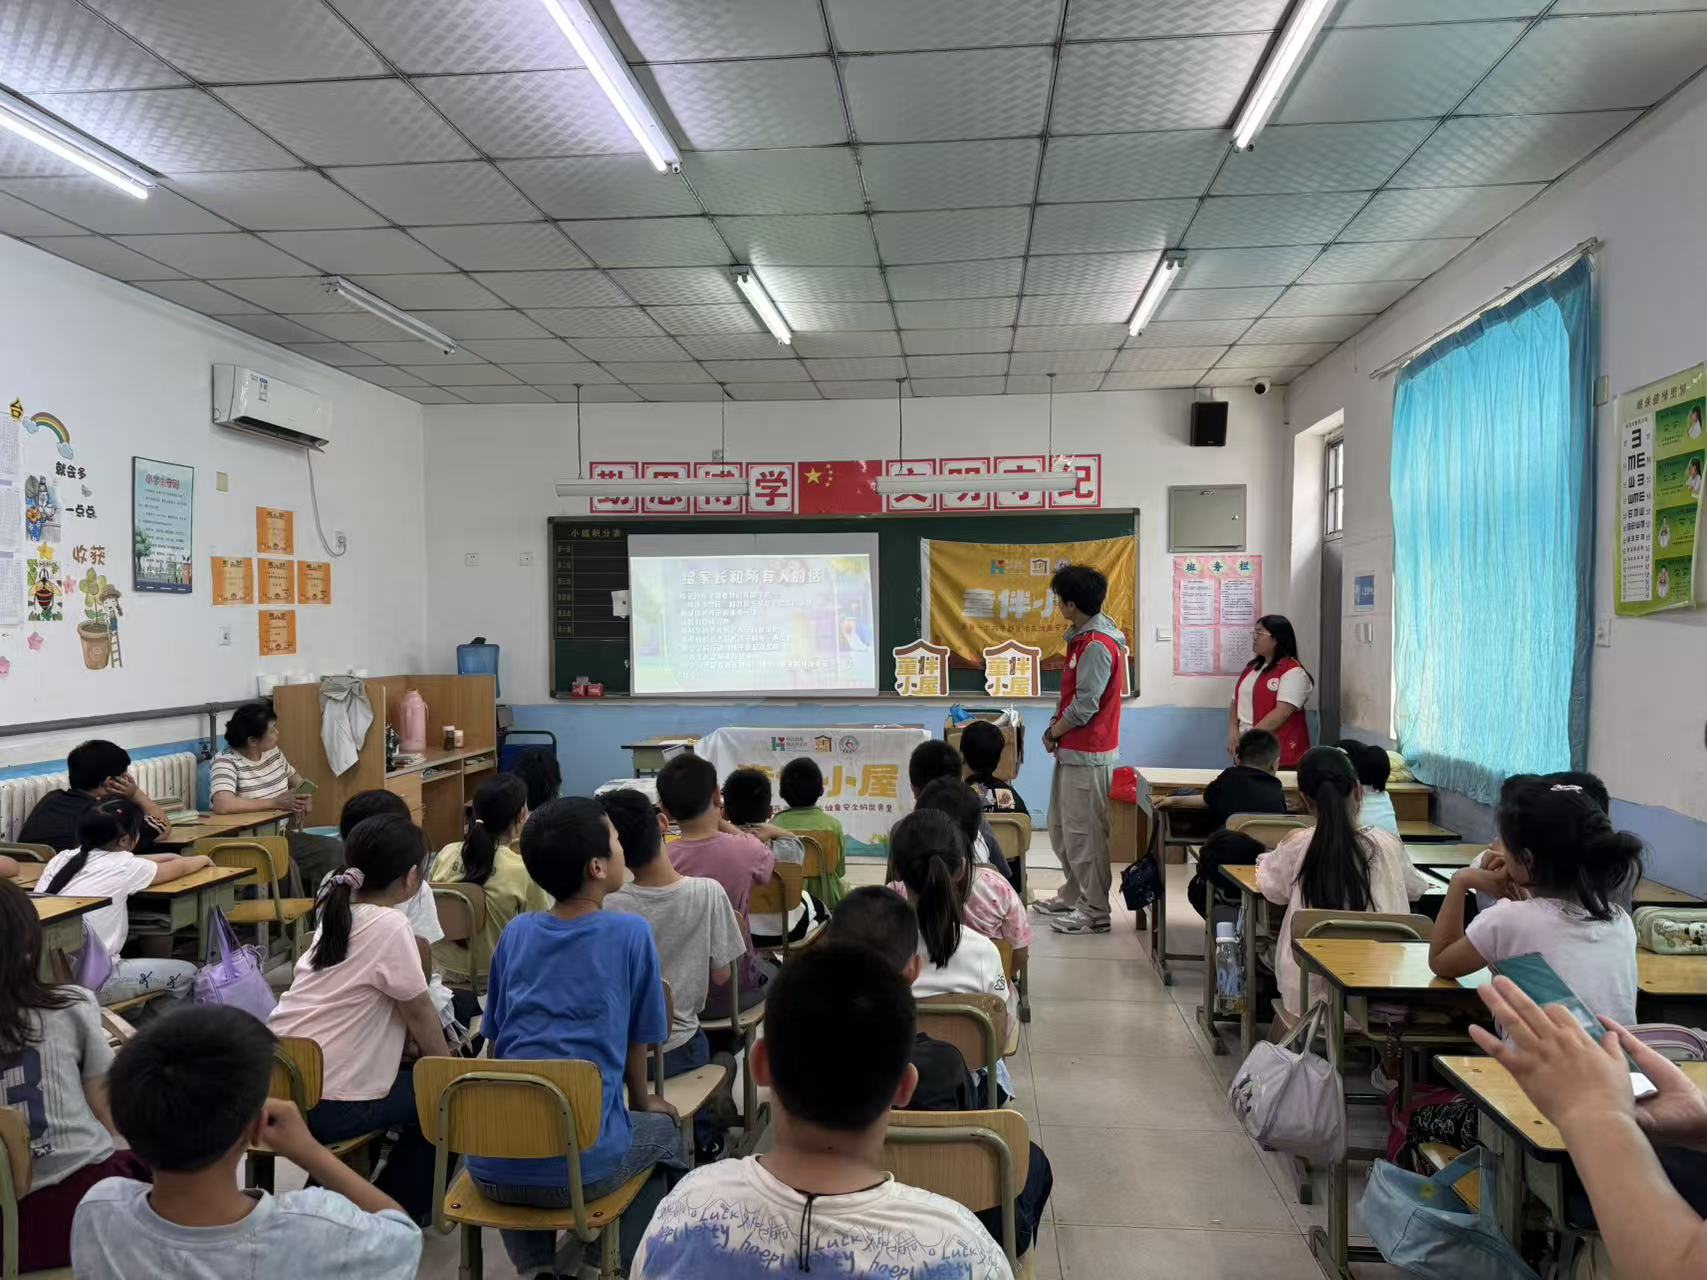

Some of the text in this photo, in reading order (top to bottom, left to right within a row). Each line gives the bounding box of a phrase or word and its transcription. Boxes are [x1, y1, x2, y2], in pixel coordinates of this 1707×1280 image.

[55, 461, 87, 480] 就会多
[65, 503, 97, 519] 一点点
[72, 545, 106, 566] 收获
[681, 568, 823, 585] 给家长和所有人的话
